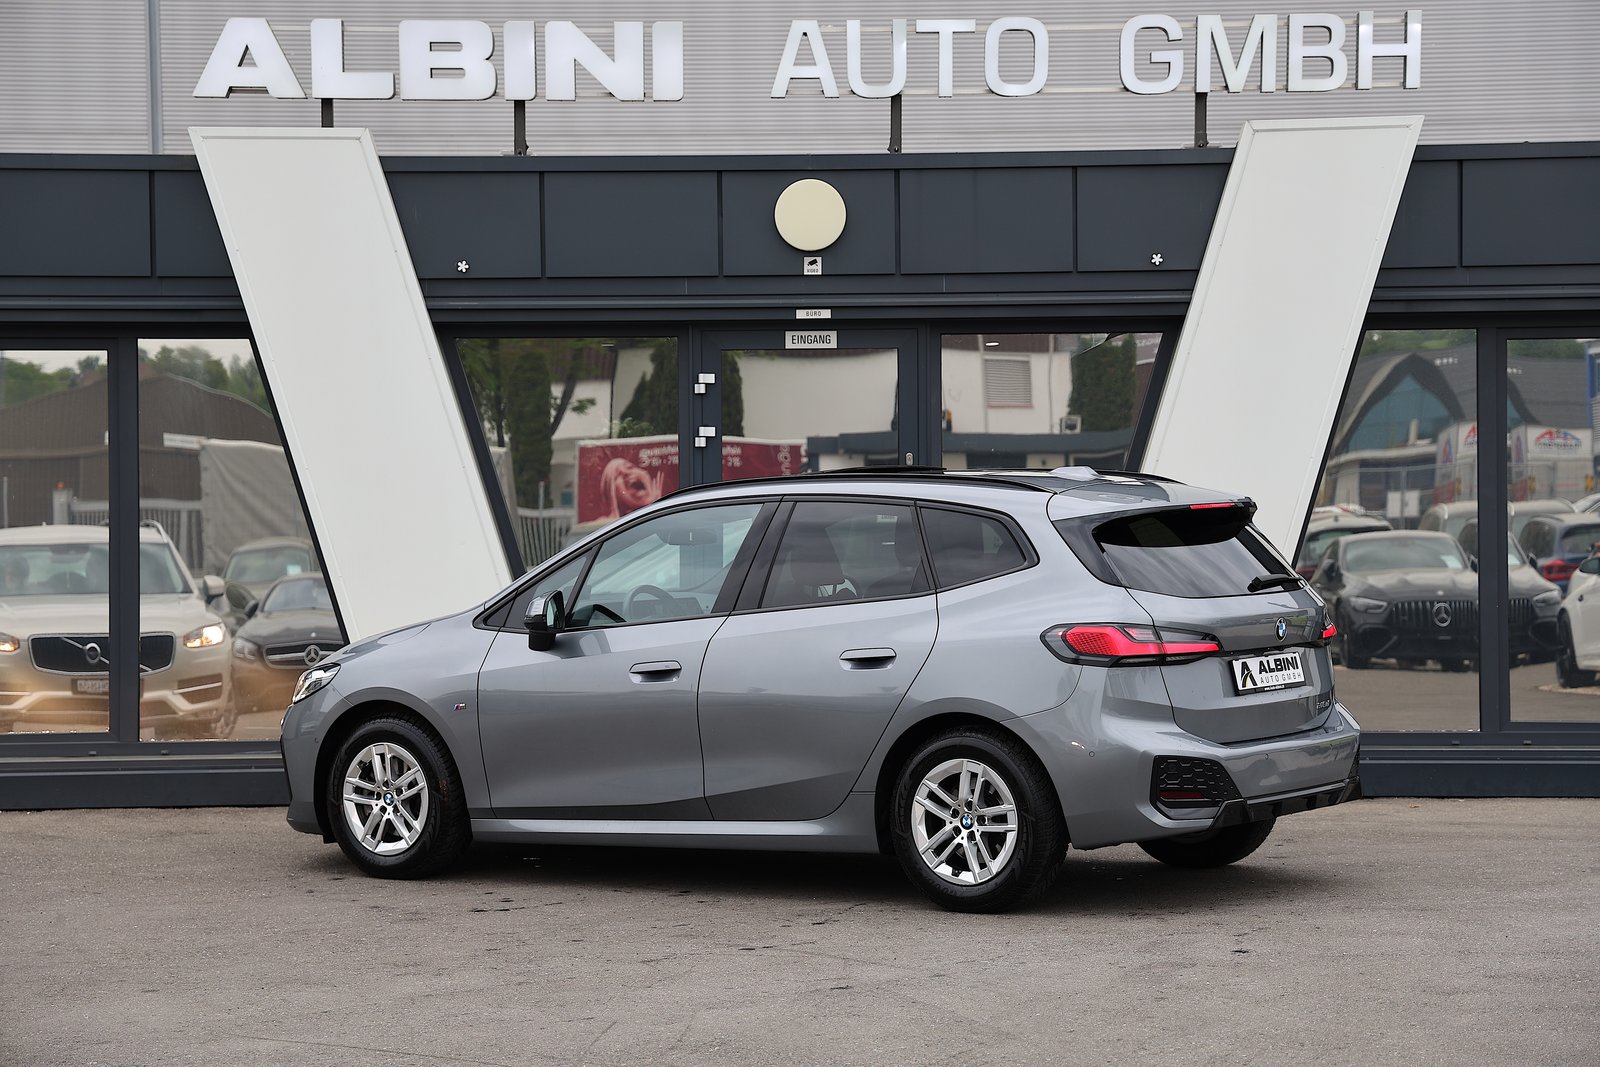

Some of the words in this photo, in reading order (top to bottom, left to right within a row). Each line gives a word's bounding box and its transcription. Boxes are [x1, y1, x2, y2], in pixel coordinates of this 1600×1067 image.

[193, 17, 684, 101] ALBINI
[771, 16, 1050, 98] AUTO
[1119, 9, 1422, 95] GMBH
[791, 334, 831, 345] EINGANG
[1259, 656, 1299, 674] ALBINI
[1260, 675, 1279, 684] AUTO
[1281, 671, 1302, 682] GMBH
